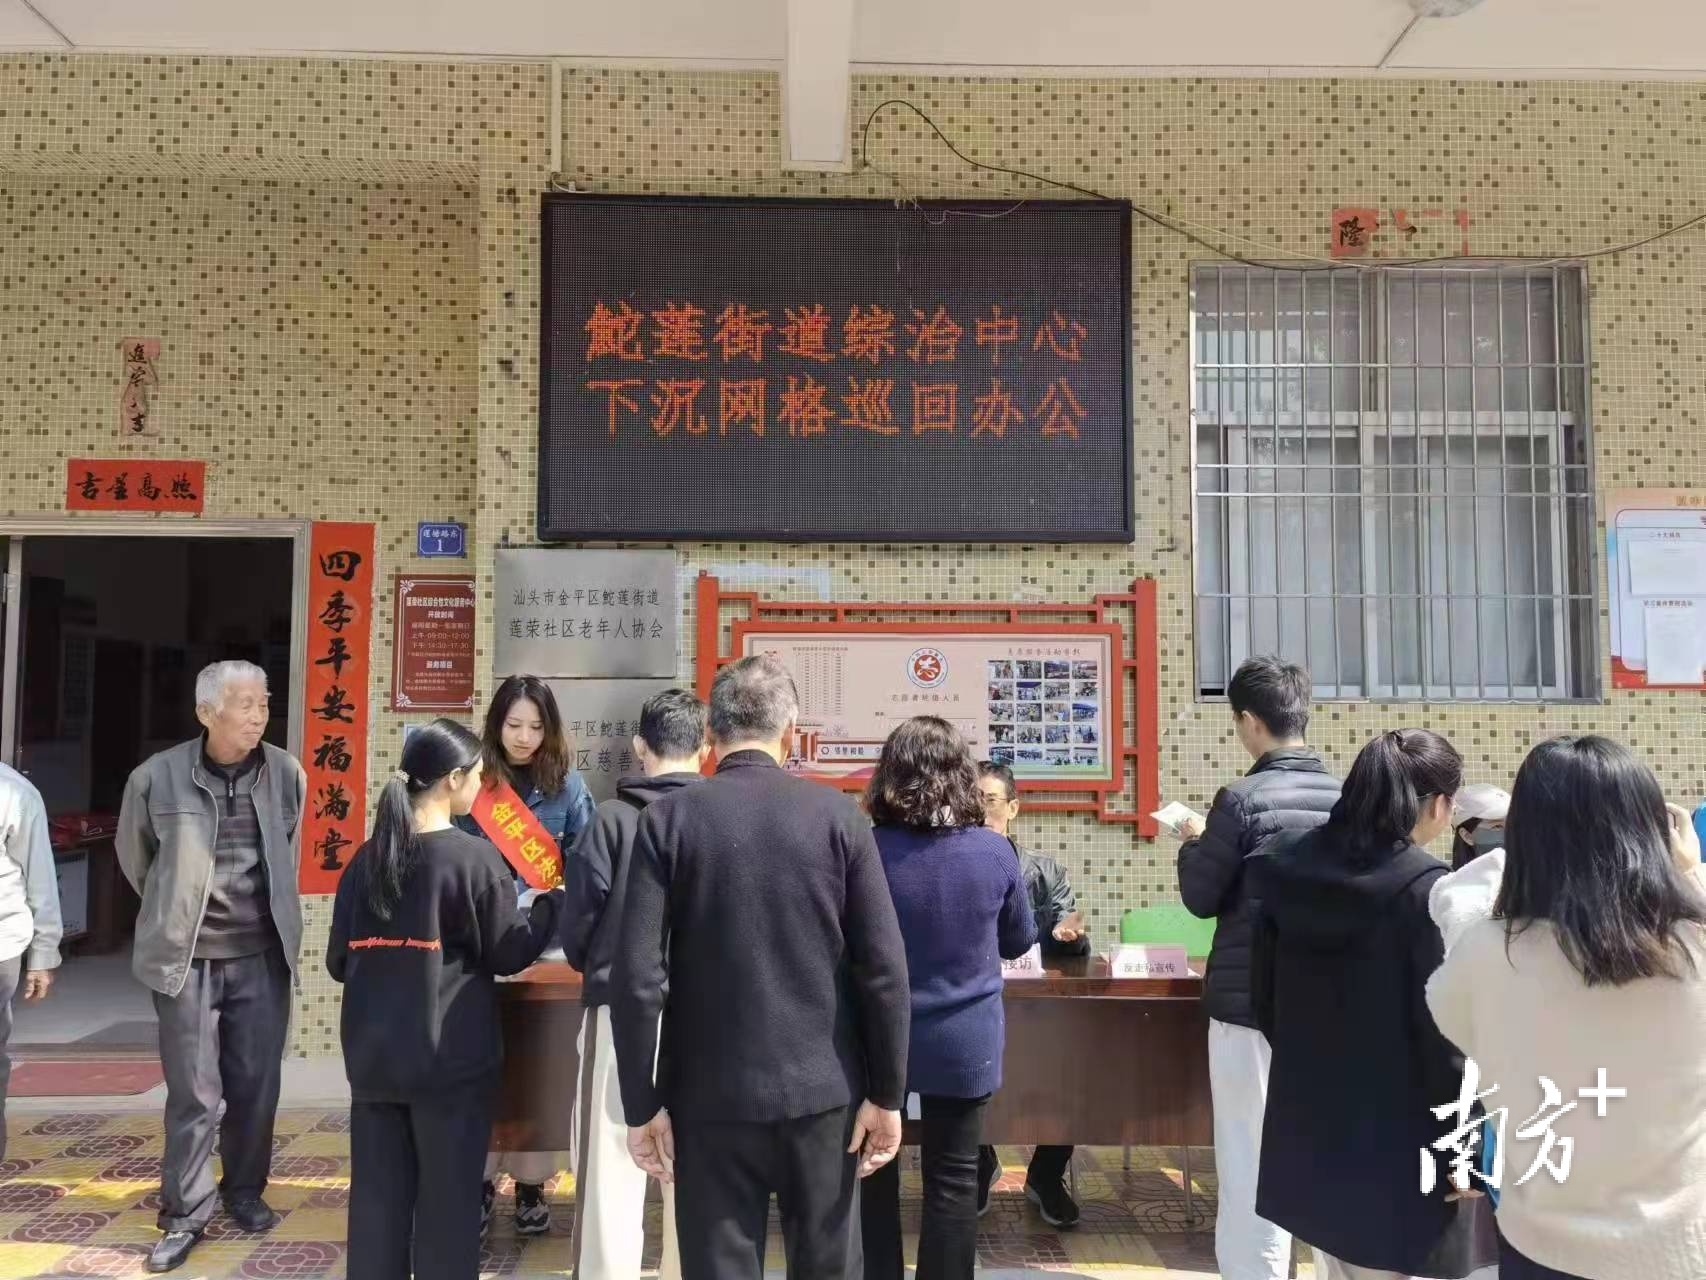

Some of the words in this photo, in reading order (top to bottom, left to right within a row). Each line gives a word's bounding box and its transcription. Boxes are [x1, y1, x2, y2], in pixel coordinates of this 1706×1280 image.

[584, 377, 1088, 439] 下沉网格巡回办公
[437, 539, 443, 552] 1
[513, 588, 660, 607] 汕头市金平区鮀莲街道
[509, 617, 664, 639] 莲荣社区老年人协会
